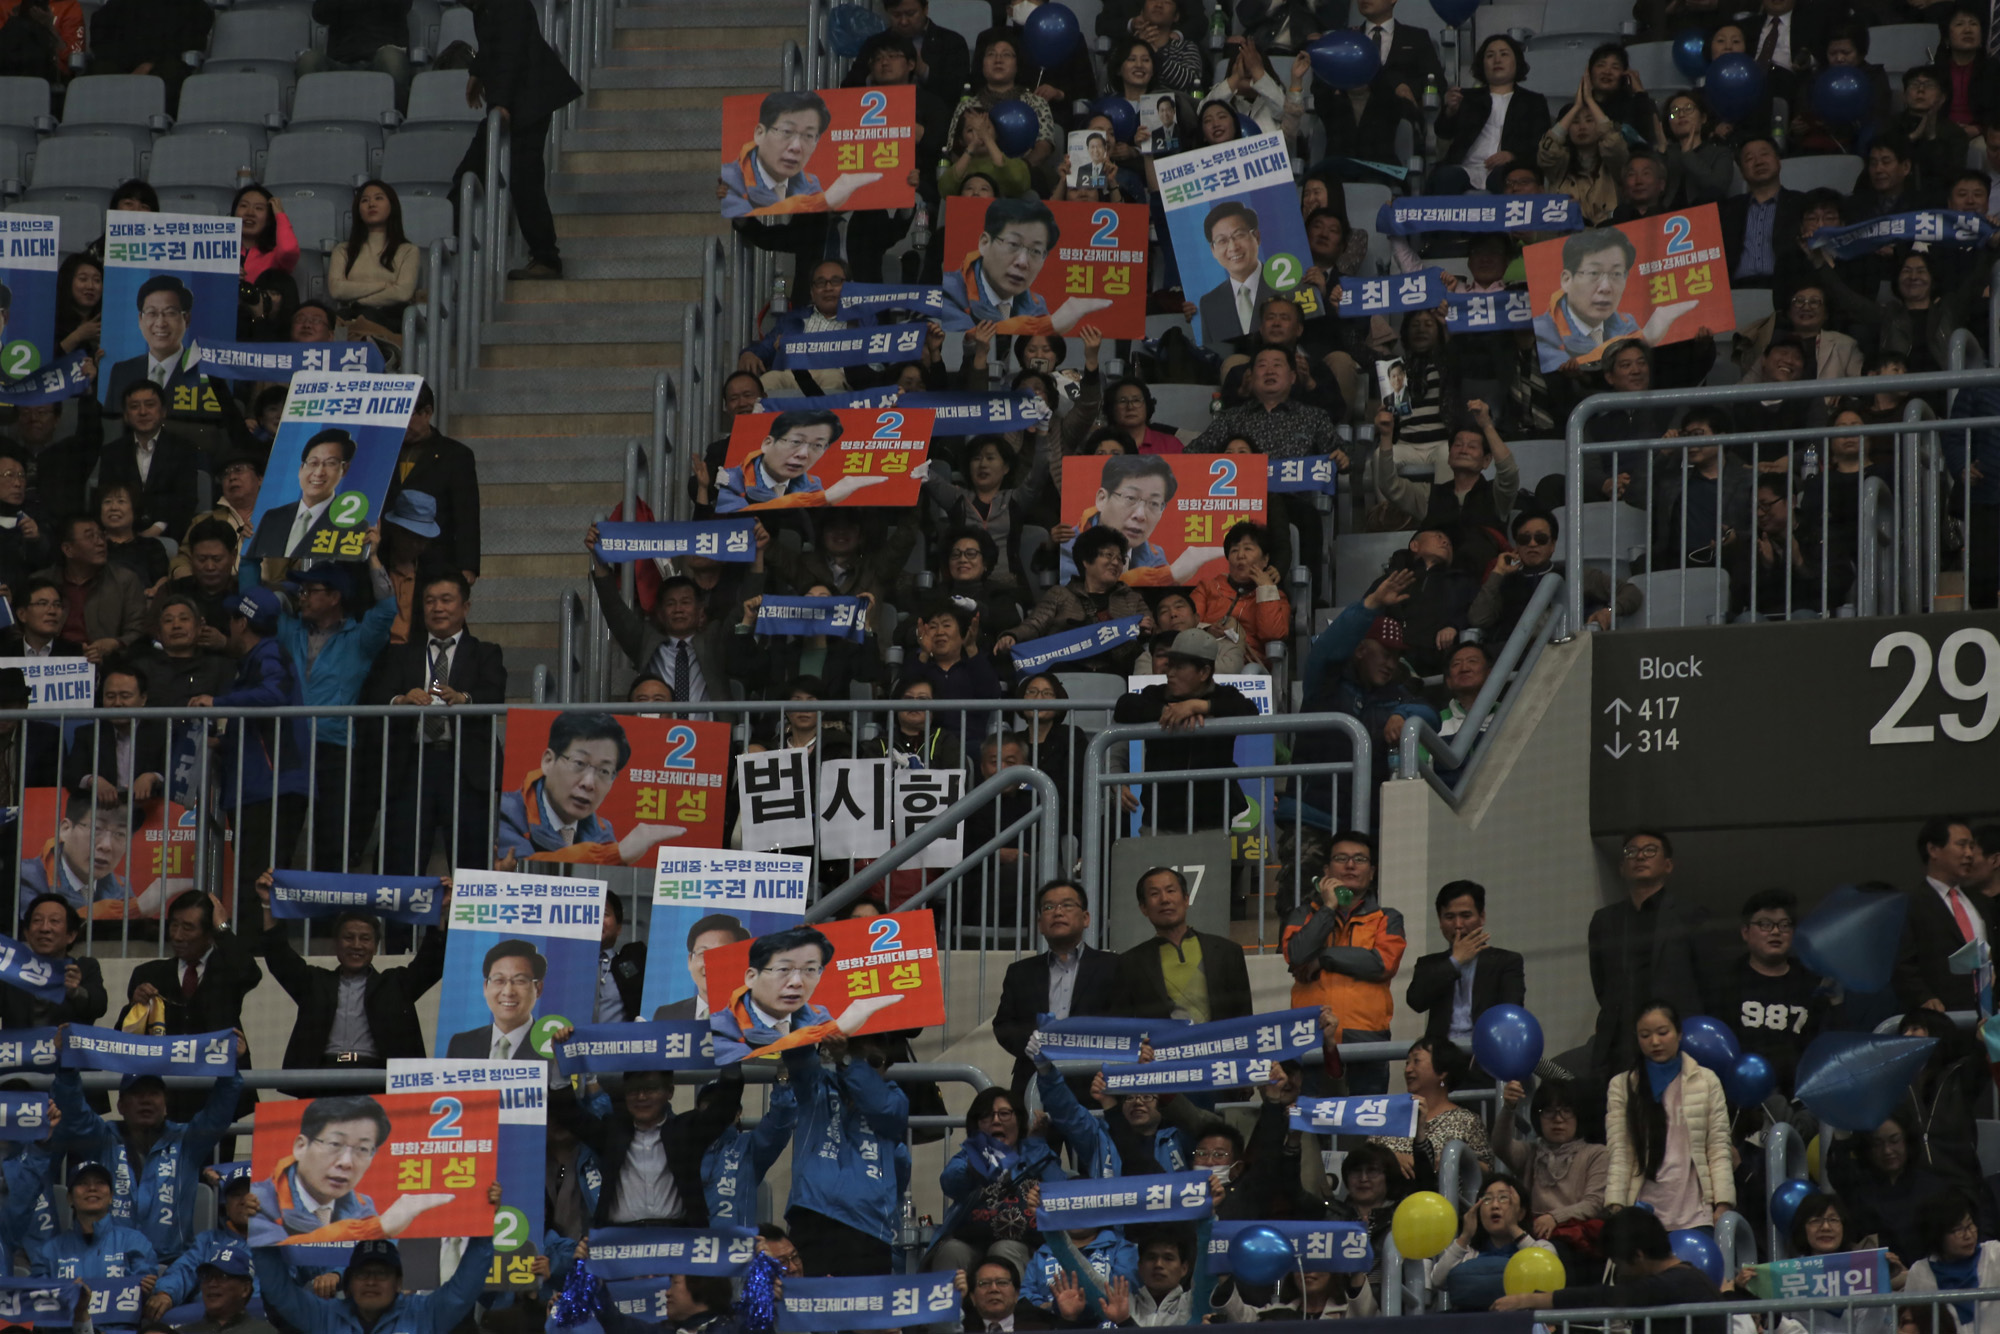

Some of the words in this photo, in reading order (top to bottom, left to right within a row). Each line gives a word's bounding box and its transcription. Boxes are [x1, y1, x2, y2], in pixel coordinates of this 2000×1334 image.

[860, 90, 887, 126] 2
[831, 127, 911, 142] 평화경제대통령
[838, 141, 899, 171] 최성
[1236, 136, 1280, 160] 정신으로
[1082, 175, 1090, 186] 2
[1164, 171, 1241, 204] 국민주권
[1244, 152, 1288, 182] 시대!
[10, 220, 54, 232] 정신으로
[1394, 207, 1496, 222] 평화경제대통령
[1504, 200, 1568, 228] 최성
[192, 222, 236, 235] 정신으로
[1090, 207, 1120, 248] 2
[1663, 215, 1694, 256] 2
[11, 238, 56, 257] 시대!
[109, 241, 187, 261] 국민주권
[192, 240, 237, 260] 시대!
[1059, 248, 1143, 263] 평화경제대통령
[1271, 257, 1296, 288] 2
[1638, 246, 1721, 276] 평화경제대통령
[1065, 264, 1130, 295] 최성
[1361, 275, 1428, 310] 최성
[1649, 264, 1714, 305] 최성
[1467, 293, 1532, 327] 최성
[785, 338, 864, 355] 평화경제대통령
[868, 330, 919, 354] 최성
[10, 344, 31, 375] 2
[200, 347, 292, 370] 화경제대통령
[302, 347, 368, 373] 최성
[172, 385, 222, 412] 최성
[372, 381, 415, 392] 정신으로
[288, 398, 362, 417] 국민주권
[366, 397, 412, 415] 시대!
[873, 411, 904, 439] 2
[840, 440, 925, 450] 평화경제대통령
[843, 452, 909, 473] 최성
[1280, 460, 1333, 483] 최성
[1208, 458, 1238, 496] 2
[335, 495, 362, 524] 2
[1177, 498, 1263, 512] 평화경제대통령
[311, 529, 366, 555] 최성
[601, 538, 688, 552] 평화경제대통령
[695, 530, 749, 555] 최성
[44, 662, 89, 677] 정신으로
[1640, 654, 1703, 680] Block
[44, 680, 91, 702] 시대!
[1869, 627, 2000, 745] 29
[1638, 696, 1680, 720] 417
[664, 725, 697, 769] 2
[1638, 728, 1680, 752] 314
[629, 768, 722, 787] 평화경제대통령
[635, 787, 707, 822] 최성
[661, 860, 751, 873] 김대중·노무현
[755, 862, 803, 873] 정신으로
[275, 887, 367, 905] 평화경제대통령
[376, 887, 434, 913] 최성
[457, 884, 547, 897] 김대중·노무현
[550, 885, 599, 897] 정신으로
[660, 880, 746, 899] 국민주권
[753, 880, 803, 899] 시대!
[455, 904, 542, 924] 국민주권
[549, 904, 599, 924] 시대!
[868, 918, 903, 953] 2
[836, 947, 933, 971] 평화경제대통령
[847, 963, 922, 998] 최성
[1741, 1000, 1809, 1034] 987
[69, 1036, 163, 1057] 평화경제대통령
[170, 1039, 229, 1065] 최성
[563, 1040, 657, 1058] 평화경제대통령
[1154, 1036, 1248, 1061] 평화경제대통령
[1256, 1019, 1316, 1054] 최성
[390, 1068, 486, 1089] 김대중·노무현
[489, 1067, 541, 1081] 정신으로
[1107, 1069, 1203, 1088] 평화경제대통령
[1211, 1059, 1271, 1086] 최성
[427, 1096, 463, 1139] 2
[1312, 1099, 1389, 1127] 최성
[390, 1139, 493, 1156] 평화경제대통령
[397, 1157, 476, 1191] 최성
[717, 1201, 733, 1218] 2
[1043, 1192, 1137, 1212] 평화경제대통령
[1146, 1182, 1206, 1210] 최성
[38, 1213, 54, 1231] 2
[159, 1207, 173, 1225] 2
[493, 1211, 518, 1246] 2
[589, 1243, 684, 1260] 평화경제대통령
[691, 1237, 754, 1263] 최성
[1307, 1231, 1368, 1259] 최성
[1780, 1268, 1872, 1299] 문재인
[88, 1285, 140, 1314] 최성
[784, 1296, 883, 1312] 평화경제대통령
[892, 1283, 954, 1316] 최성
